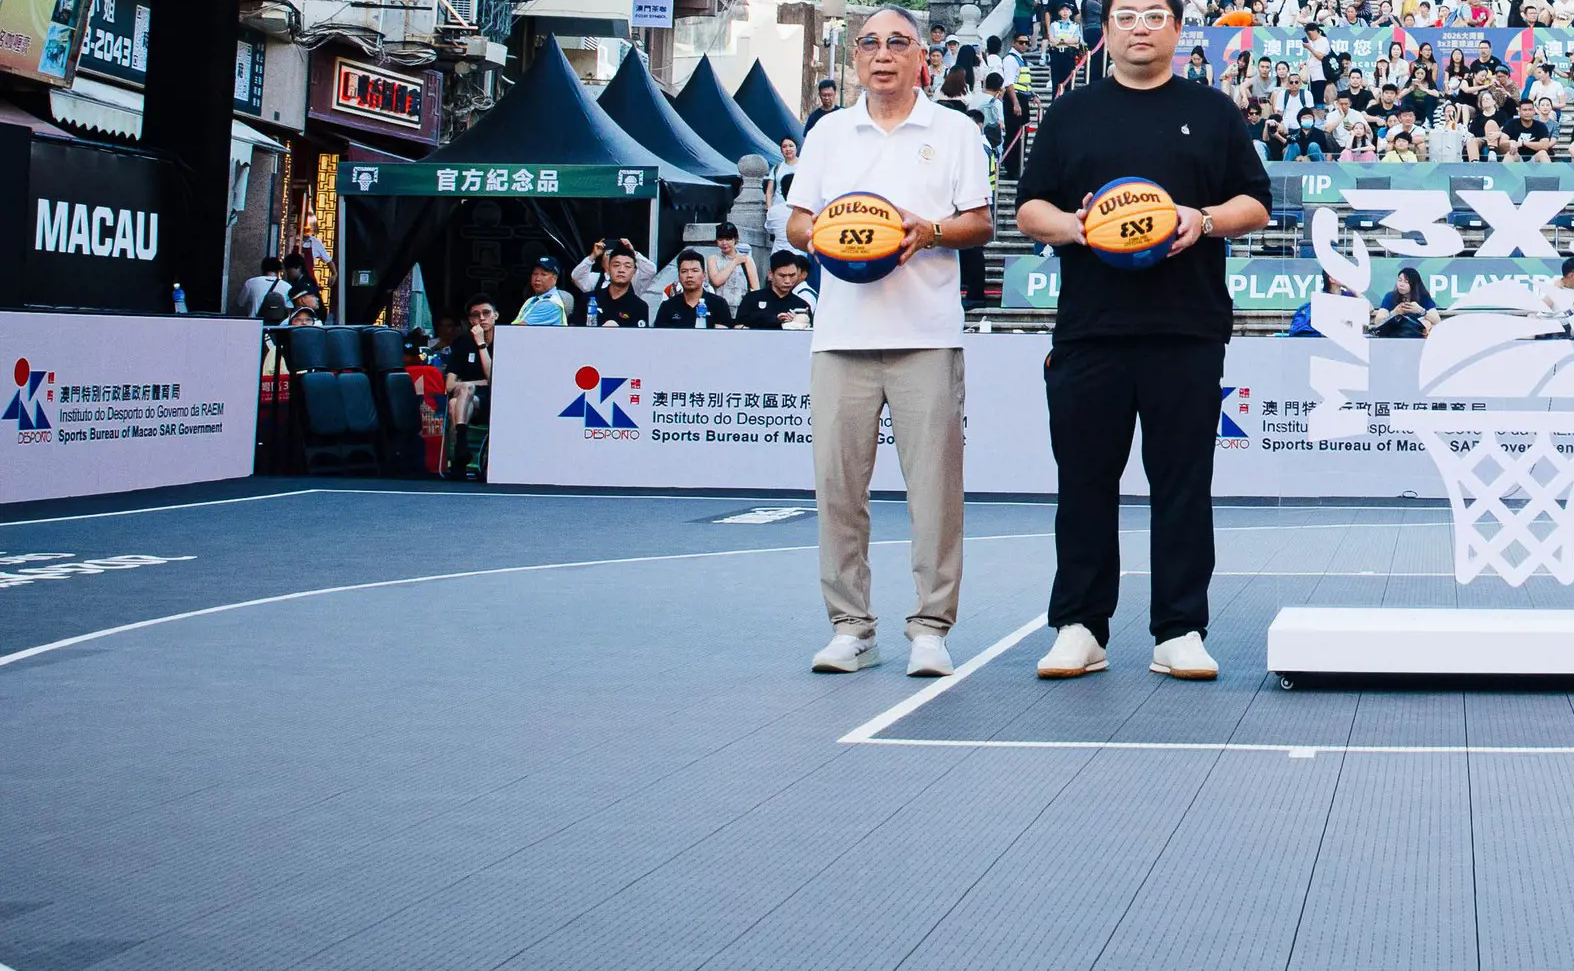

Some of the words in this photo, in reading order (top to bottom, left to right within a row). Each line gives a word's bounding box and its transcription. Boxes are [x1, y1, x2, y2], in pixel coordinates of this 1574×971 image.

[436, 168, 559, 193] 官方紀念品
[828, 201, 890, 220] Wilson
[1098, 191, 1162, 215] Wilson
[35, 198, 158, 261] MACAU
[60, 382, 181, 403] 澳門特別行政區政府體育局
[651, 391, 812, 409] 澳門特別行政區政府
[60, 407, 93, 423] Instituto
[94, 406, 106, 422] do
[107, 405, 144, 424] Desporto
[145, 404, 155, 420] do
[157, 403, 189, 418] Governo
[190, 403, 200, 418] da
[201, 401, 224, 416] RAEM
[652, 410, 709, 426] Instituto
[713, 410, 733, 426] do
[737, 410, 803, 429] Desporto
[58, 428, 88, 445] Sports
[90, 426, 119, 441] Bureau
[121, 425, 131, 440] of
[132, 424, 158, 438] Macao
[159, 423, 177, 436] SAR
[178, 421, 223, 435] Government
[583, 429, 640, 441] DESPORTO
[651, 429, 701, 445] Sports
[705, 429, 760, 444] Bureau
[764, 429, 780, 444] of
[783, 430, 813, 444] Mac
[1216, 438, 1250, 449] PORTO
[1320, 438, 1371, 451] Bureau
[1376, 438, 1392, 451] of
[1396, 438, 1426, 452] Mac
